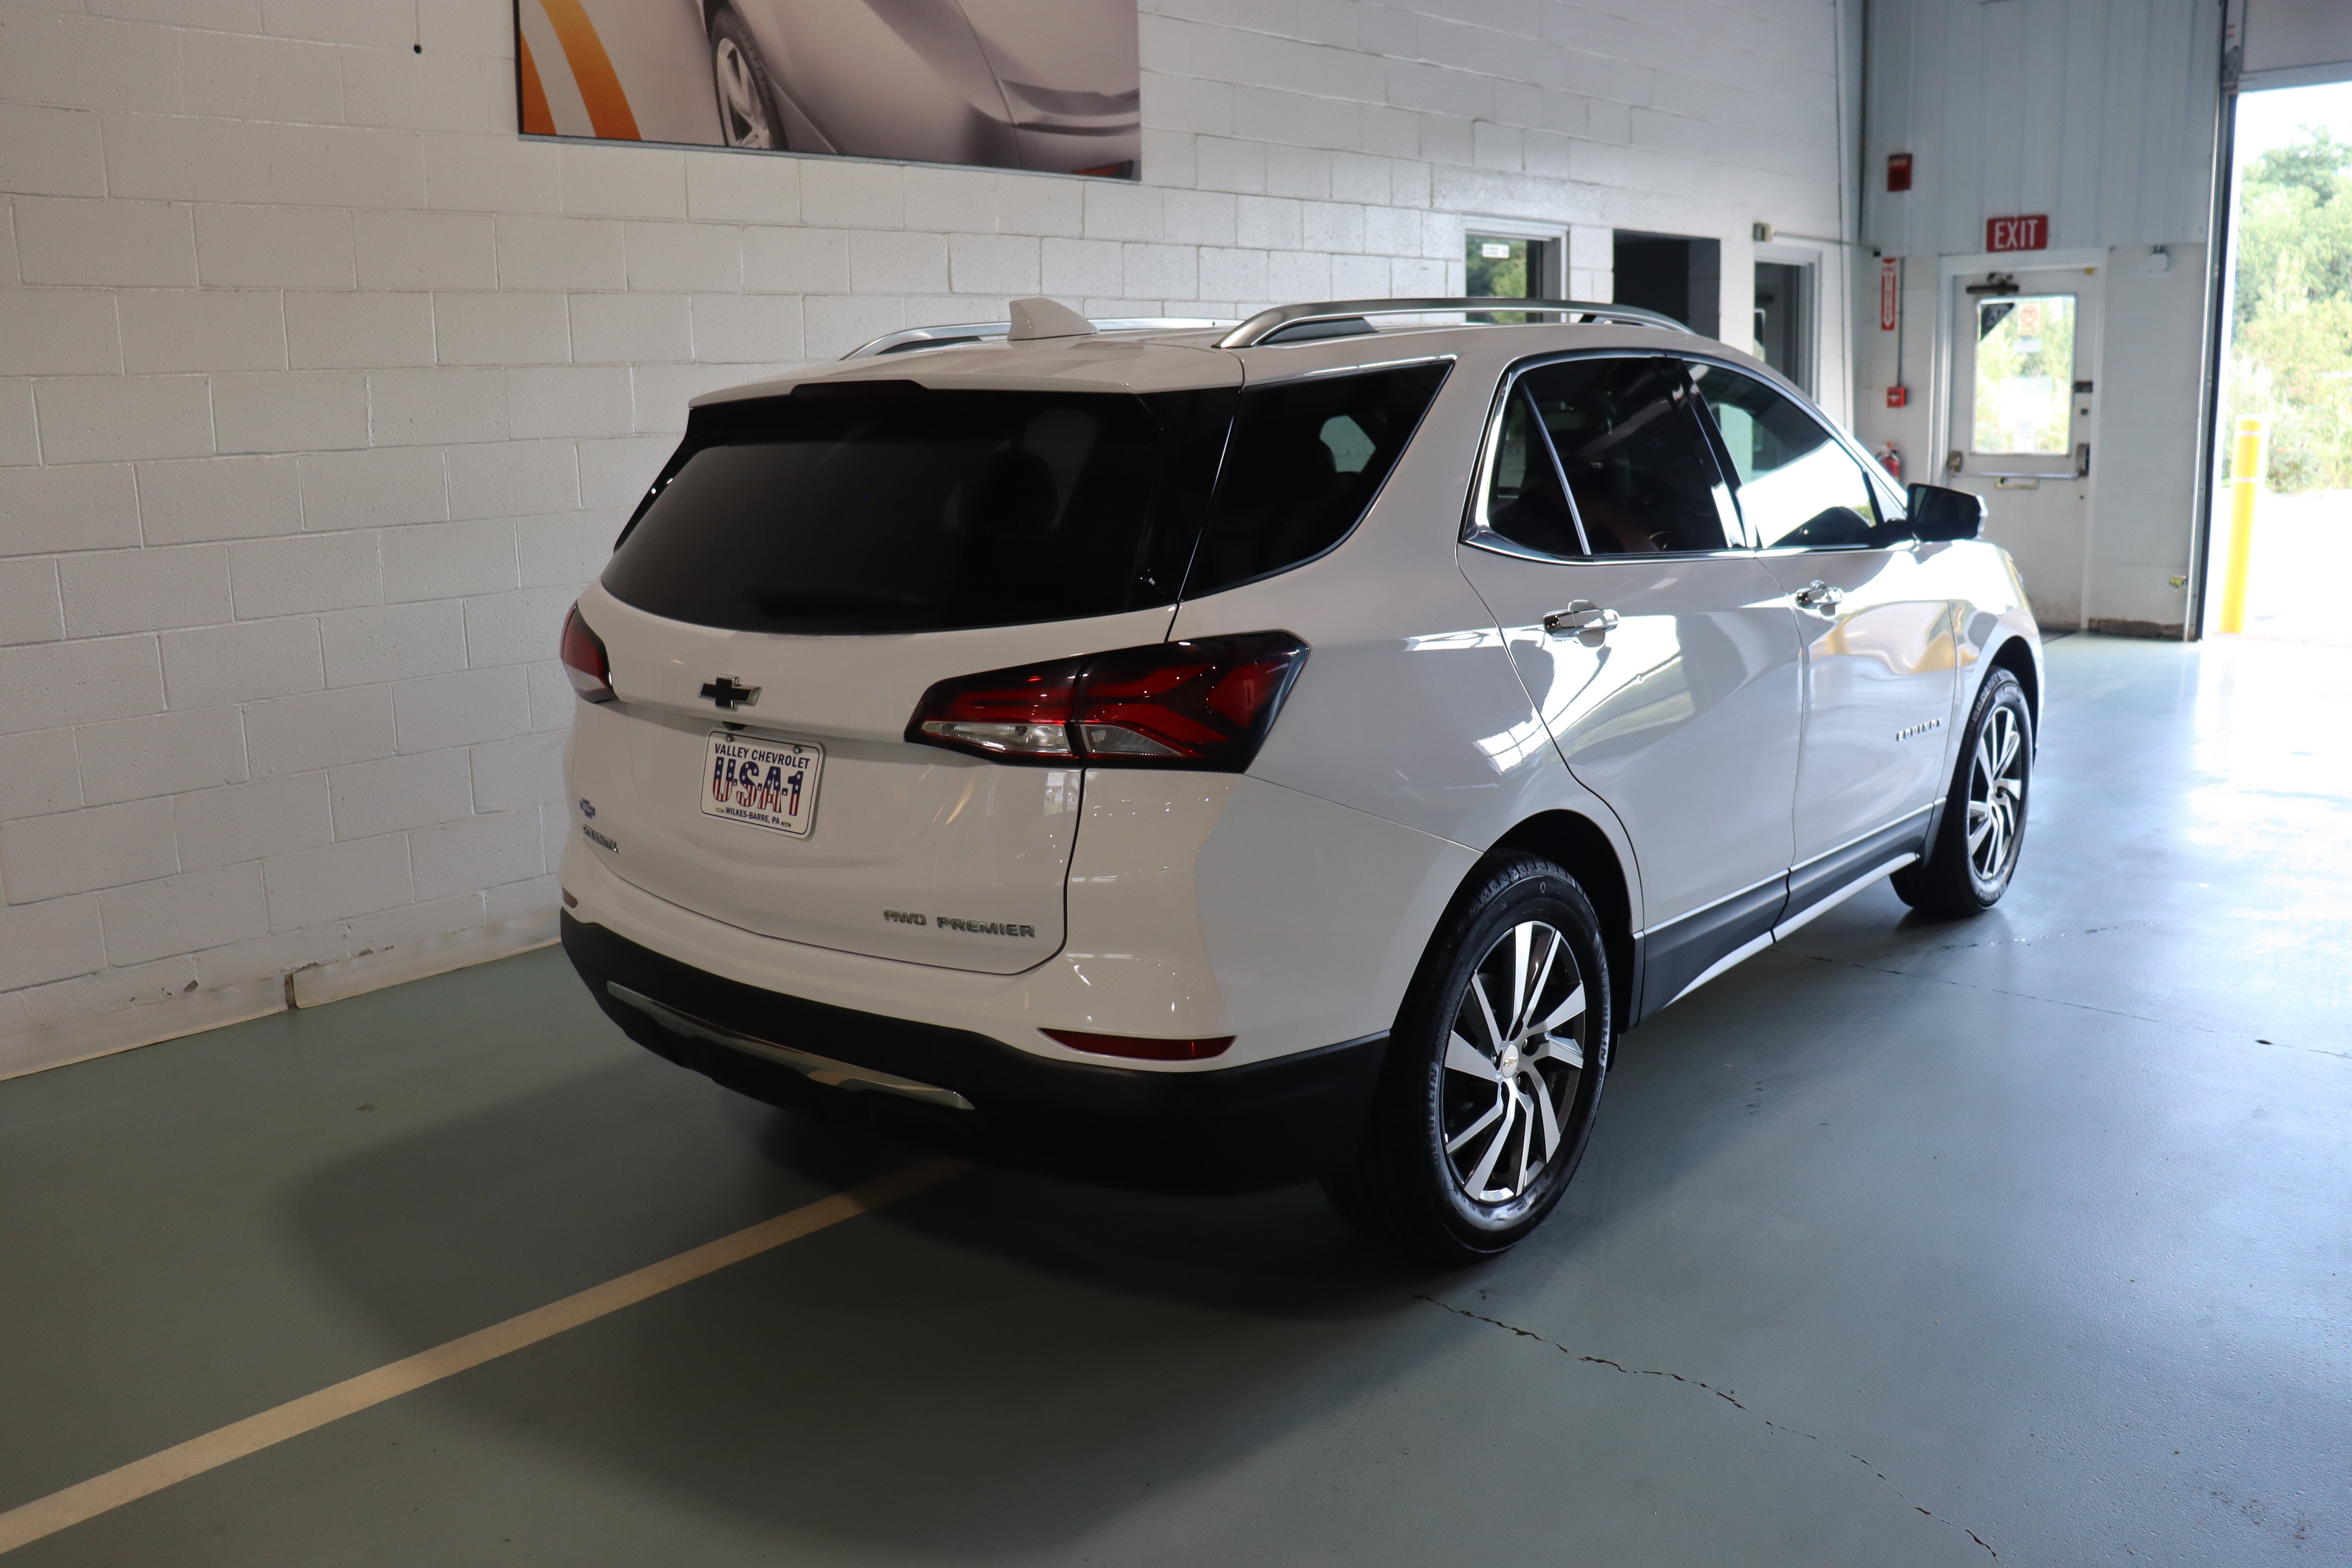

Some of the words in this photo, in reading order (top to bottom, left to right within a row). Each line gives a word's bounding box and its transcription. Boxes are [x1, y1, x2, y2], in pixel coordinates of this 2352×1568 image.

[1994, 219, 2039, 249] EXIT
[1896, 717, 1943, 741] EQUINOX
[715, 743, 749, 758] VALLEY
[751, 749, 811, 769] CHEVROLET
[726, 806, 771, 824] WILKES-BARRE,
[772, 817, 780, 825] PA
[884, 909, 927, 925] AWD
[937, 916, 1036, 938] PREMIER
